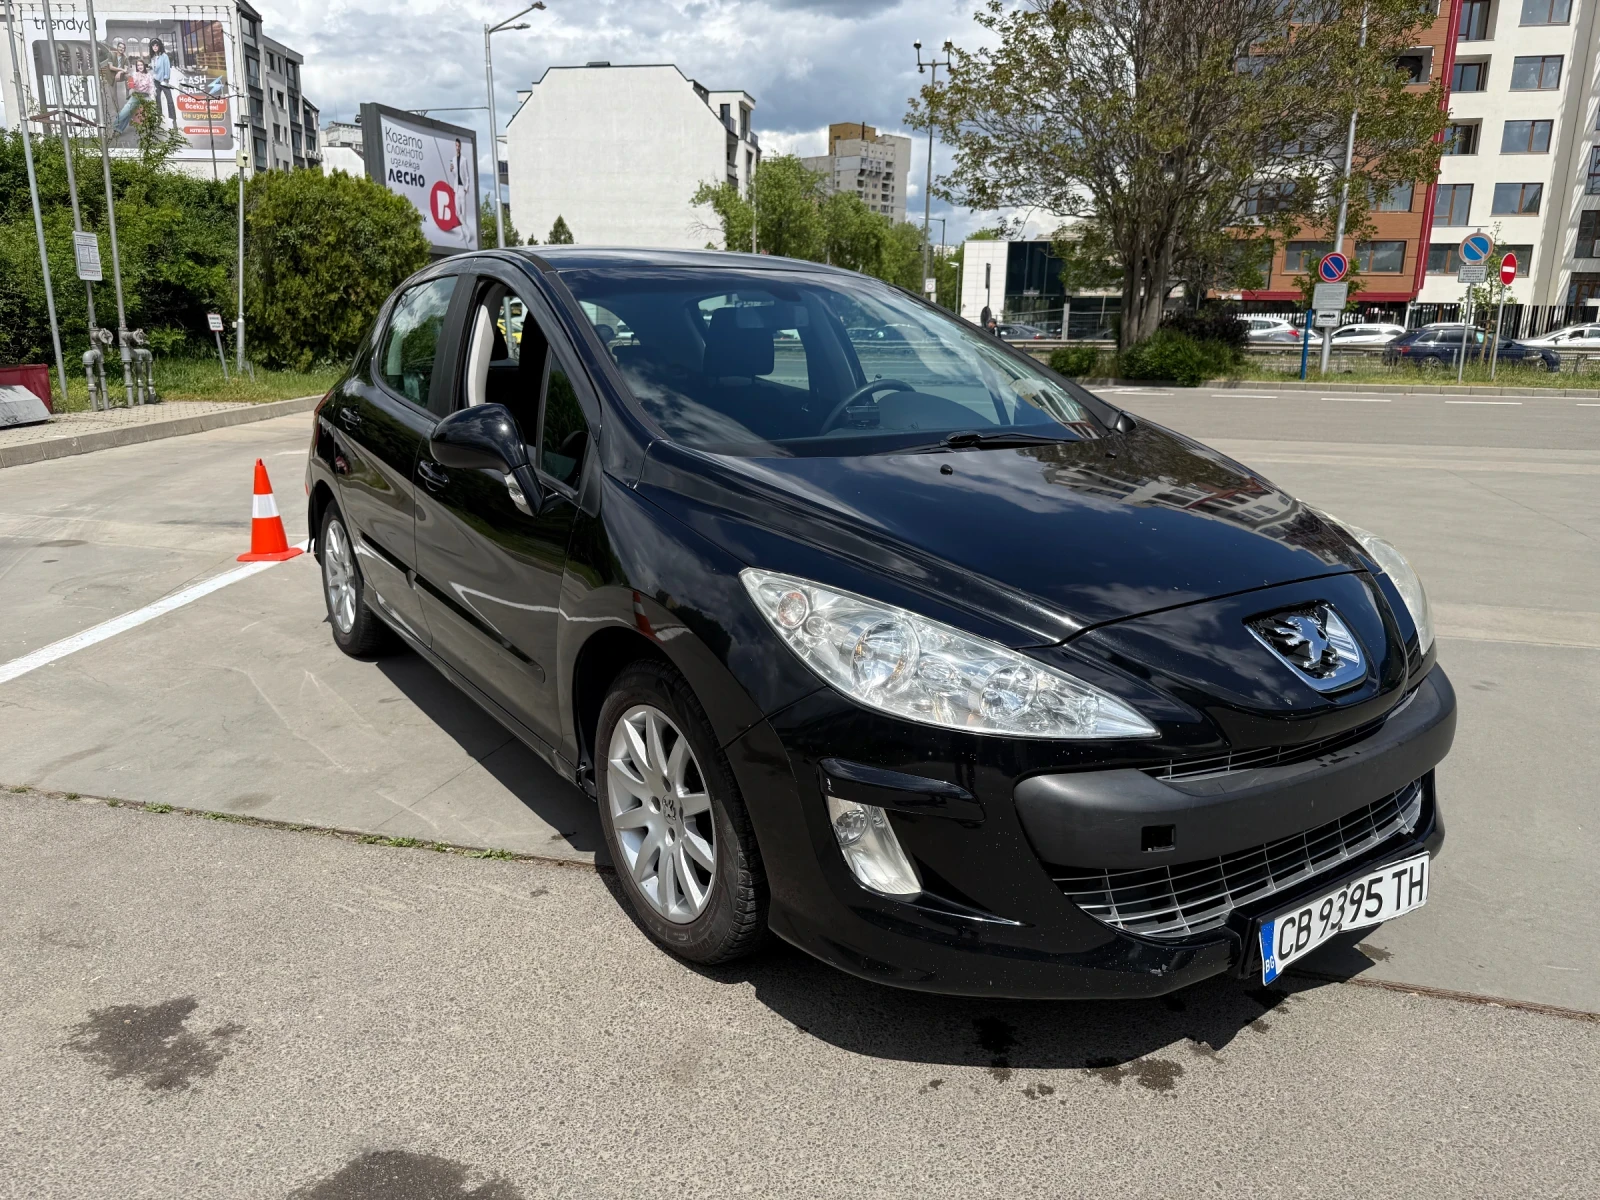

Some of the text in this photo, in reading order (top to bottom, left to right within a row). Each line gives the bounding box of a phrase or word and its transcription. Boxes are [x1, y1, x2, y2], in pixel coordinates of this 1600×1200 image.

[385, 126, 423, 149] Когато
[390, 157, 420, 172] изглежда
[1278, 862, 1425, 961] CB 9395 TH
[1265, 956, 1275, 973] BG
